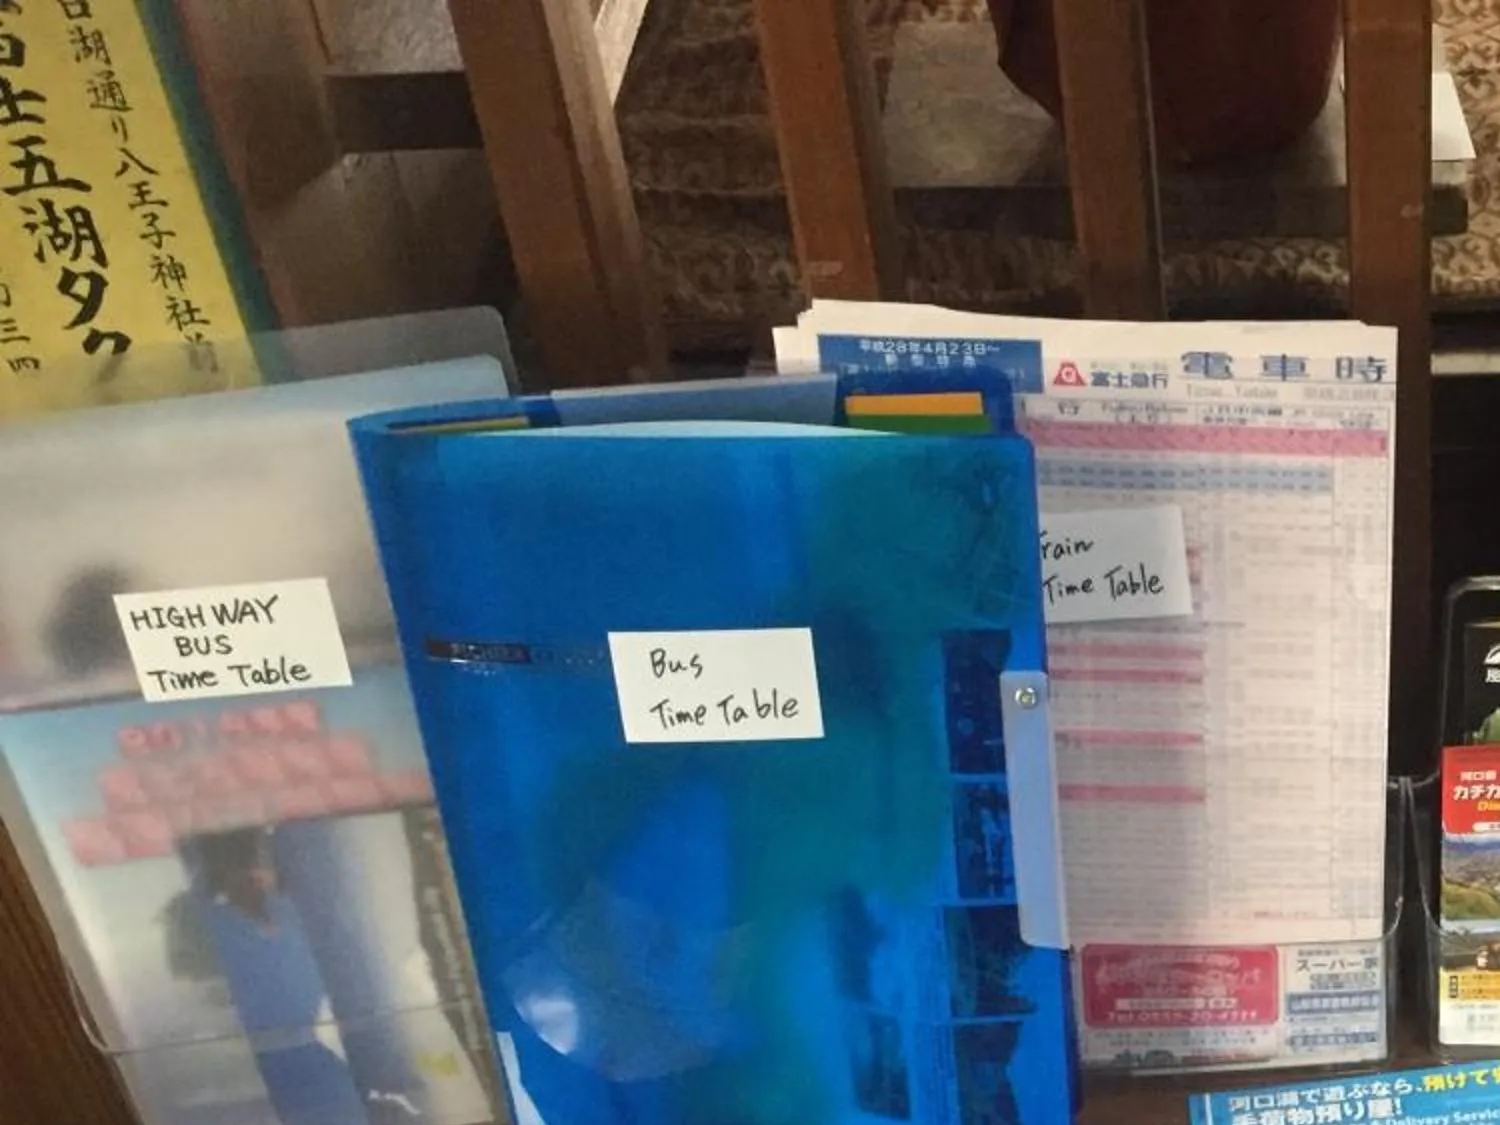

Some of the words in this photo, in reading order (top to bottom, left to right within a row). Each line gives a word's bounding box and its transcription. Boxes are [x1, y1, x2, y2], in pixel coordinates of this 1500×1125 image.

[1181, 351, 1388, 383] 電車時
[1043, 574, 1095, 605] Time
[1104, 562, 1164, 601] Table
[176, 635, 234, 658] BUS
[650, 648, 704, 678] Bus
[148, 669, 219, 693] Time
[228, 656, 312, 684] Table
[650, 698, 707, 730] Time
[716, 688, 799, 724] Table
